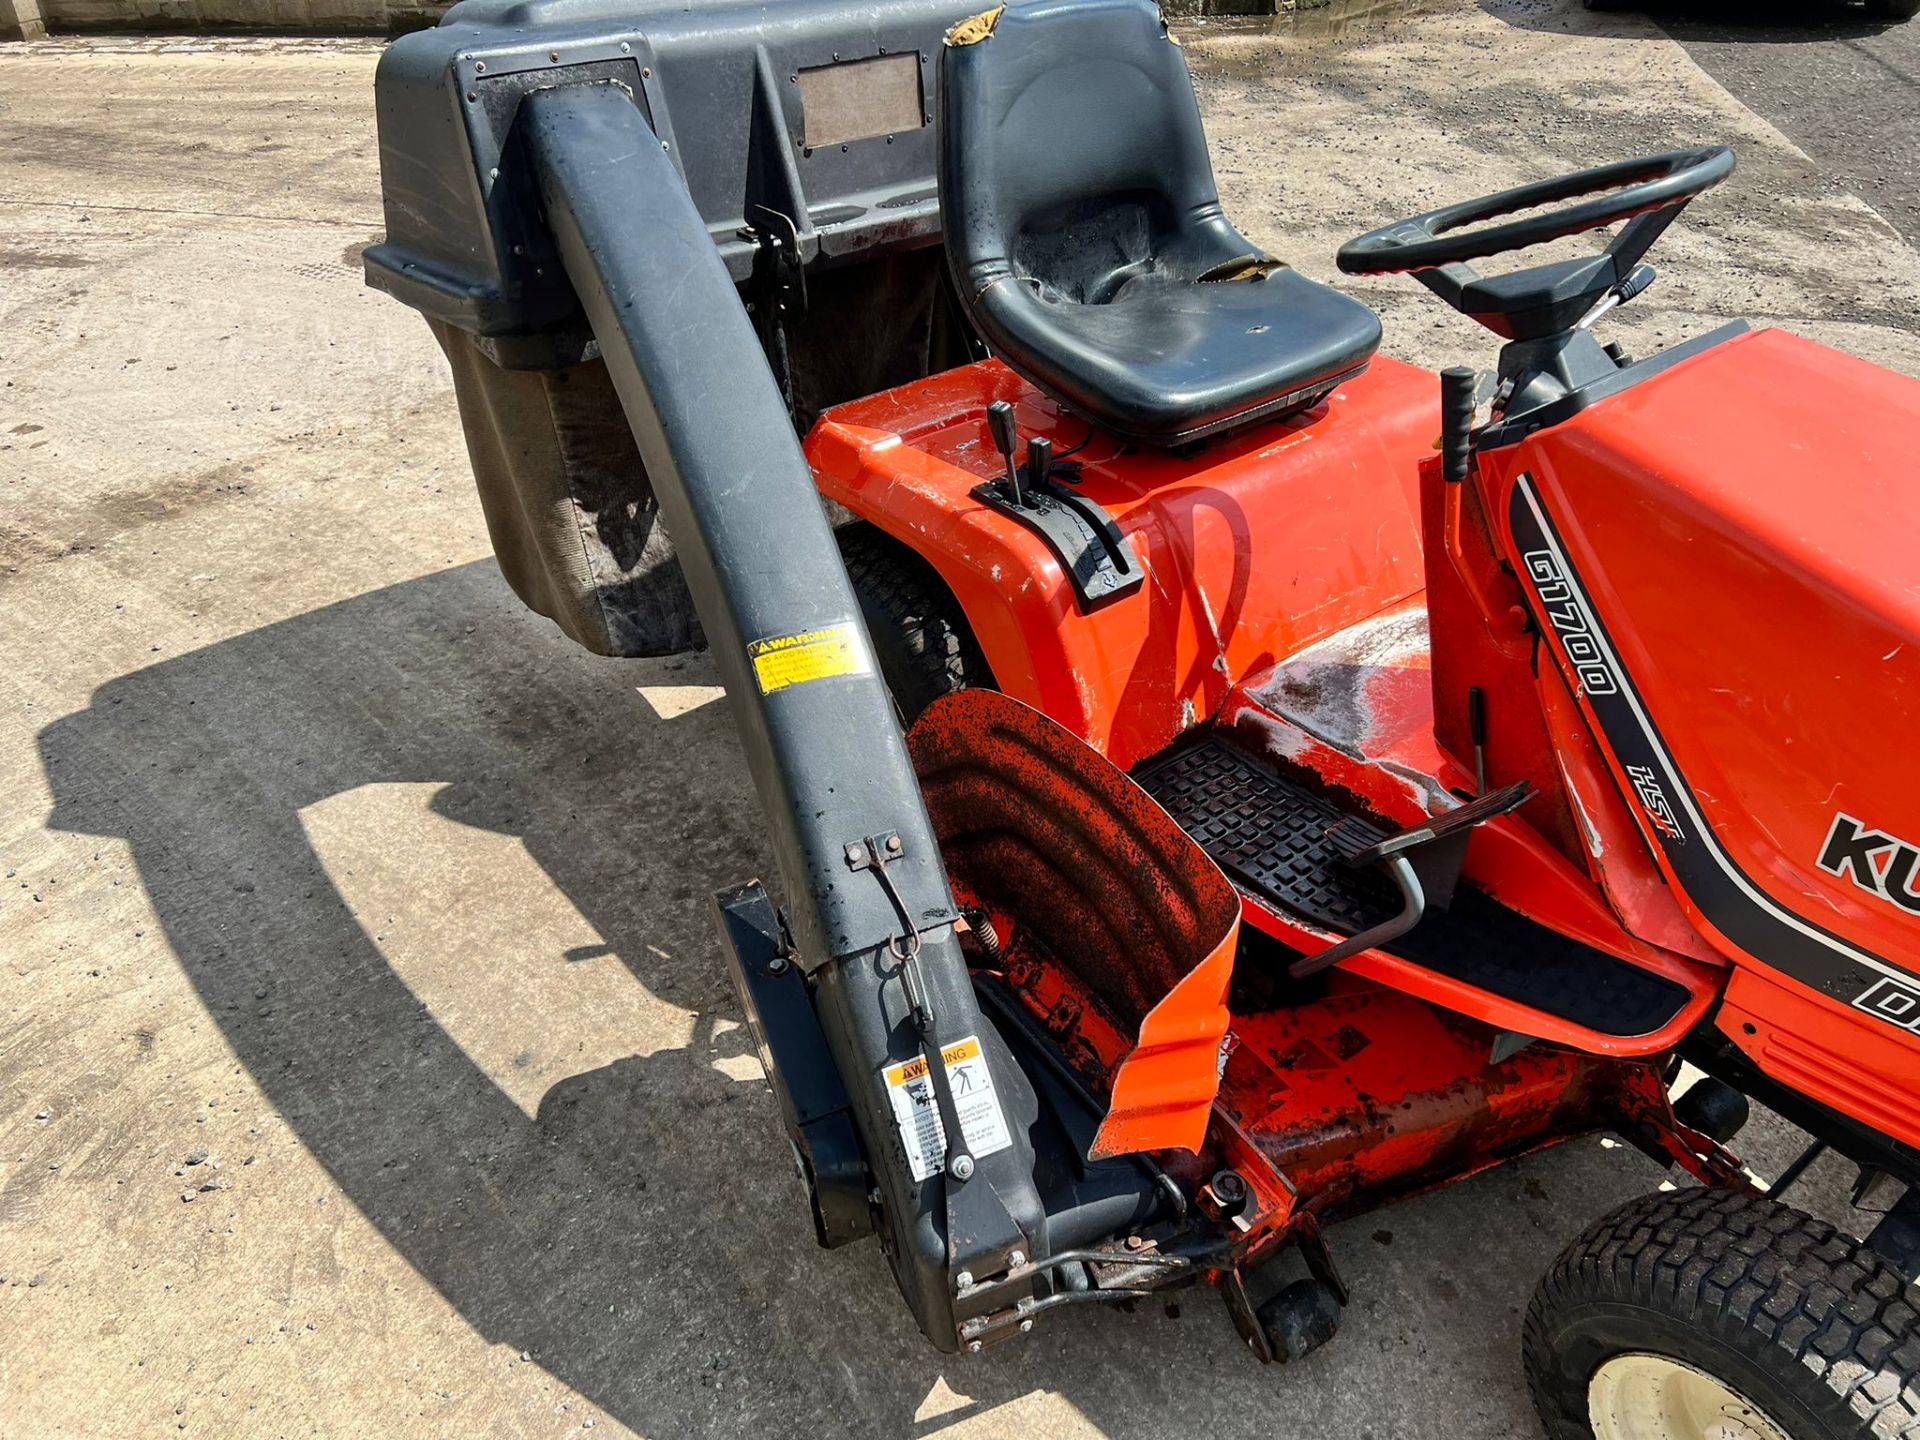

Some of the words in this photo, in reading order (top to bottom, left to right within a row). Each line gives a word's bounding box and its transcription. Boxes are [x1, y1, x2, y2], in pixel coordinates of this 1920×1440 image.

[1524, 550, 1617, 695] G1700
[1852, 977, 1920, 1034] D
[913, 1048, 966, 1076] WAING
